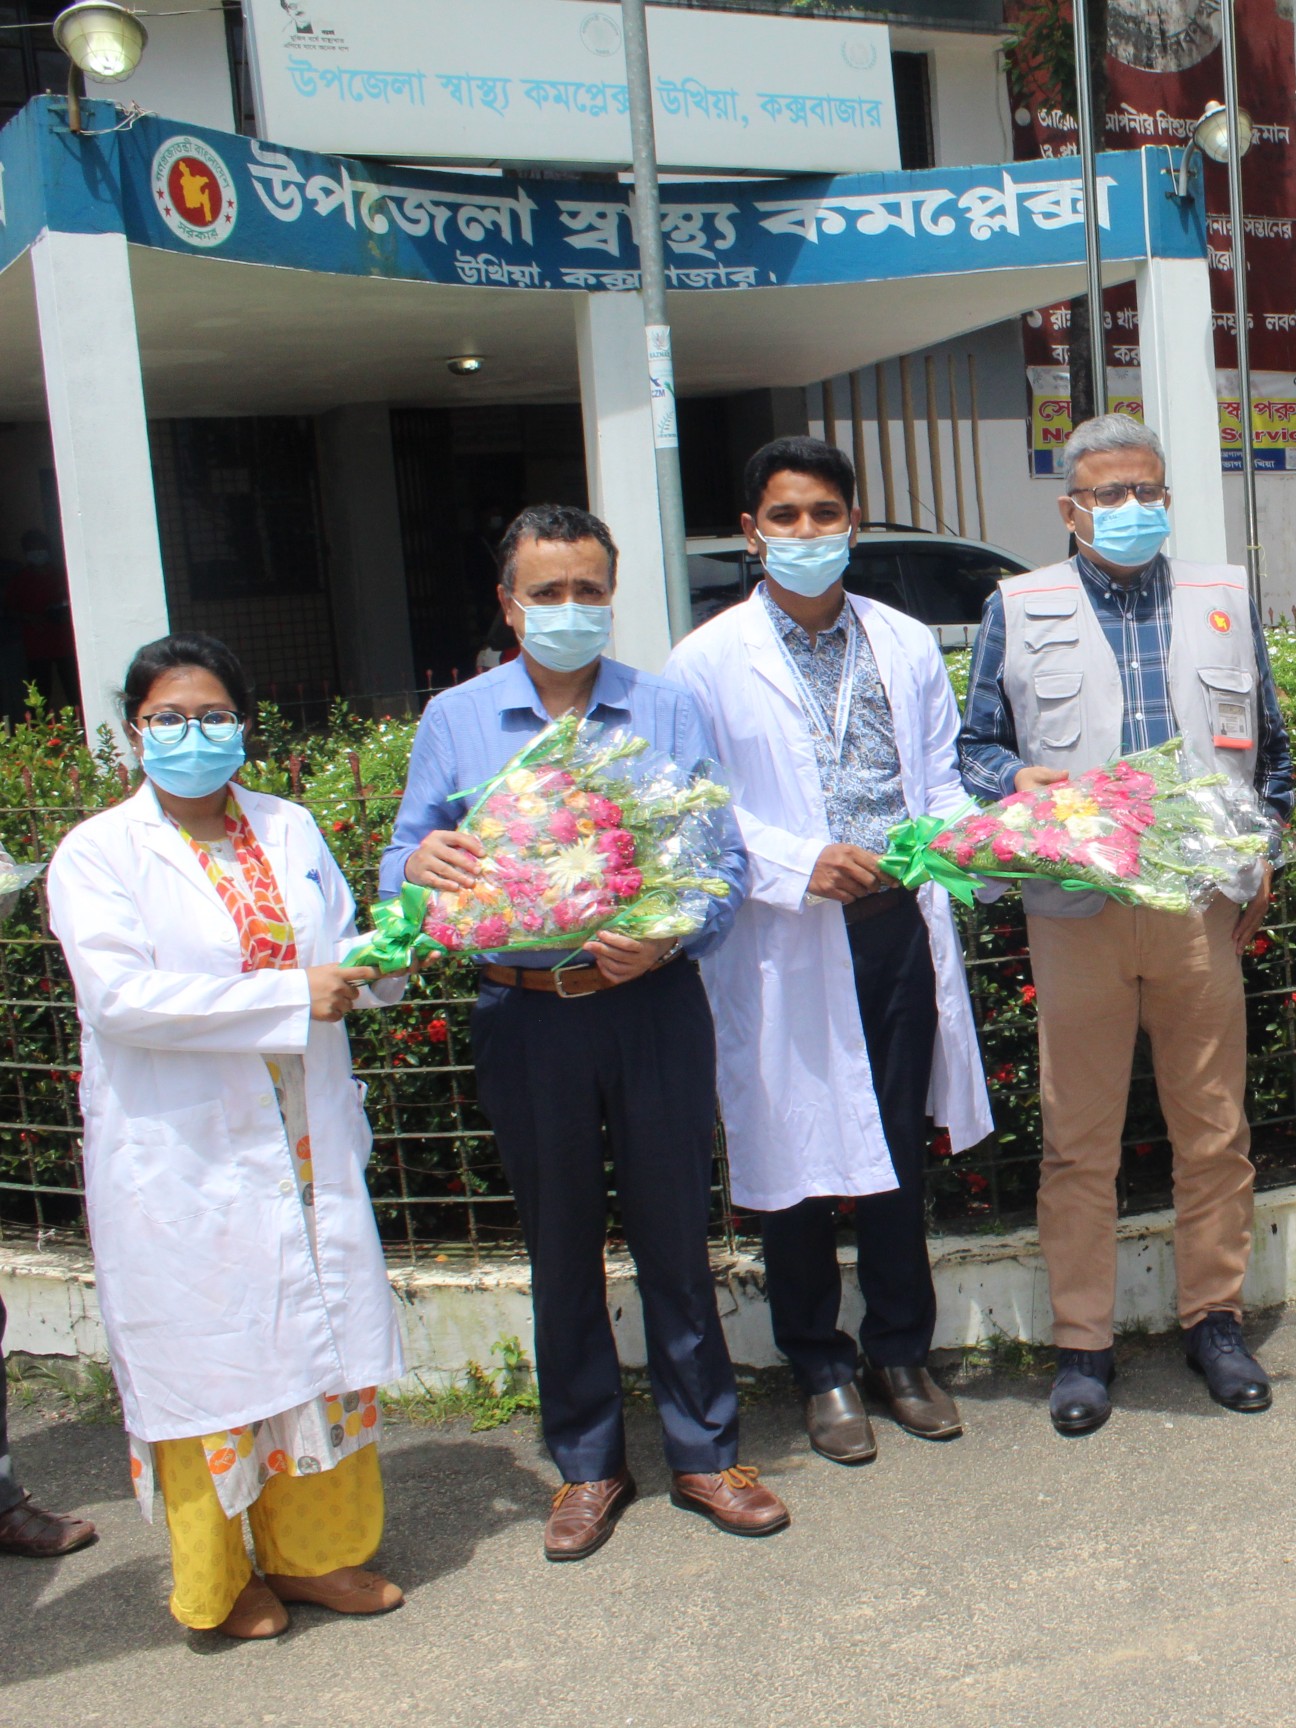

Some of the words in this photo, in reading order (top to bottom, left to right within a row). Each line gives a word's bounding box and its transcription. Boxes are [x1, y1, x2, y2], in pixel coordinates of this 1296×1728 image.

[286, 54, 427, 106] উপজেলা
[435, 72, 512, 117] স্বাস্থ্য
[756, 93, 882, 128] কক্সবাজার
[247, 138, 539, 247] উপজেলা
[753, 171, 1118, 244] কমপ্লেক্স
[559, 262, 760, 291] কক্সাজার
